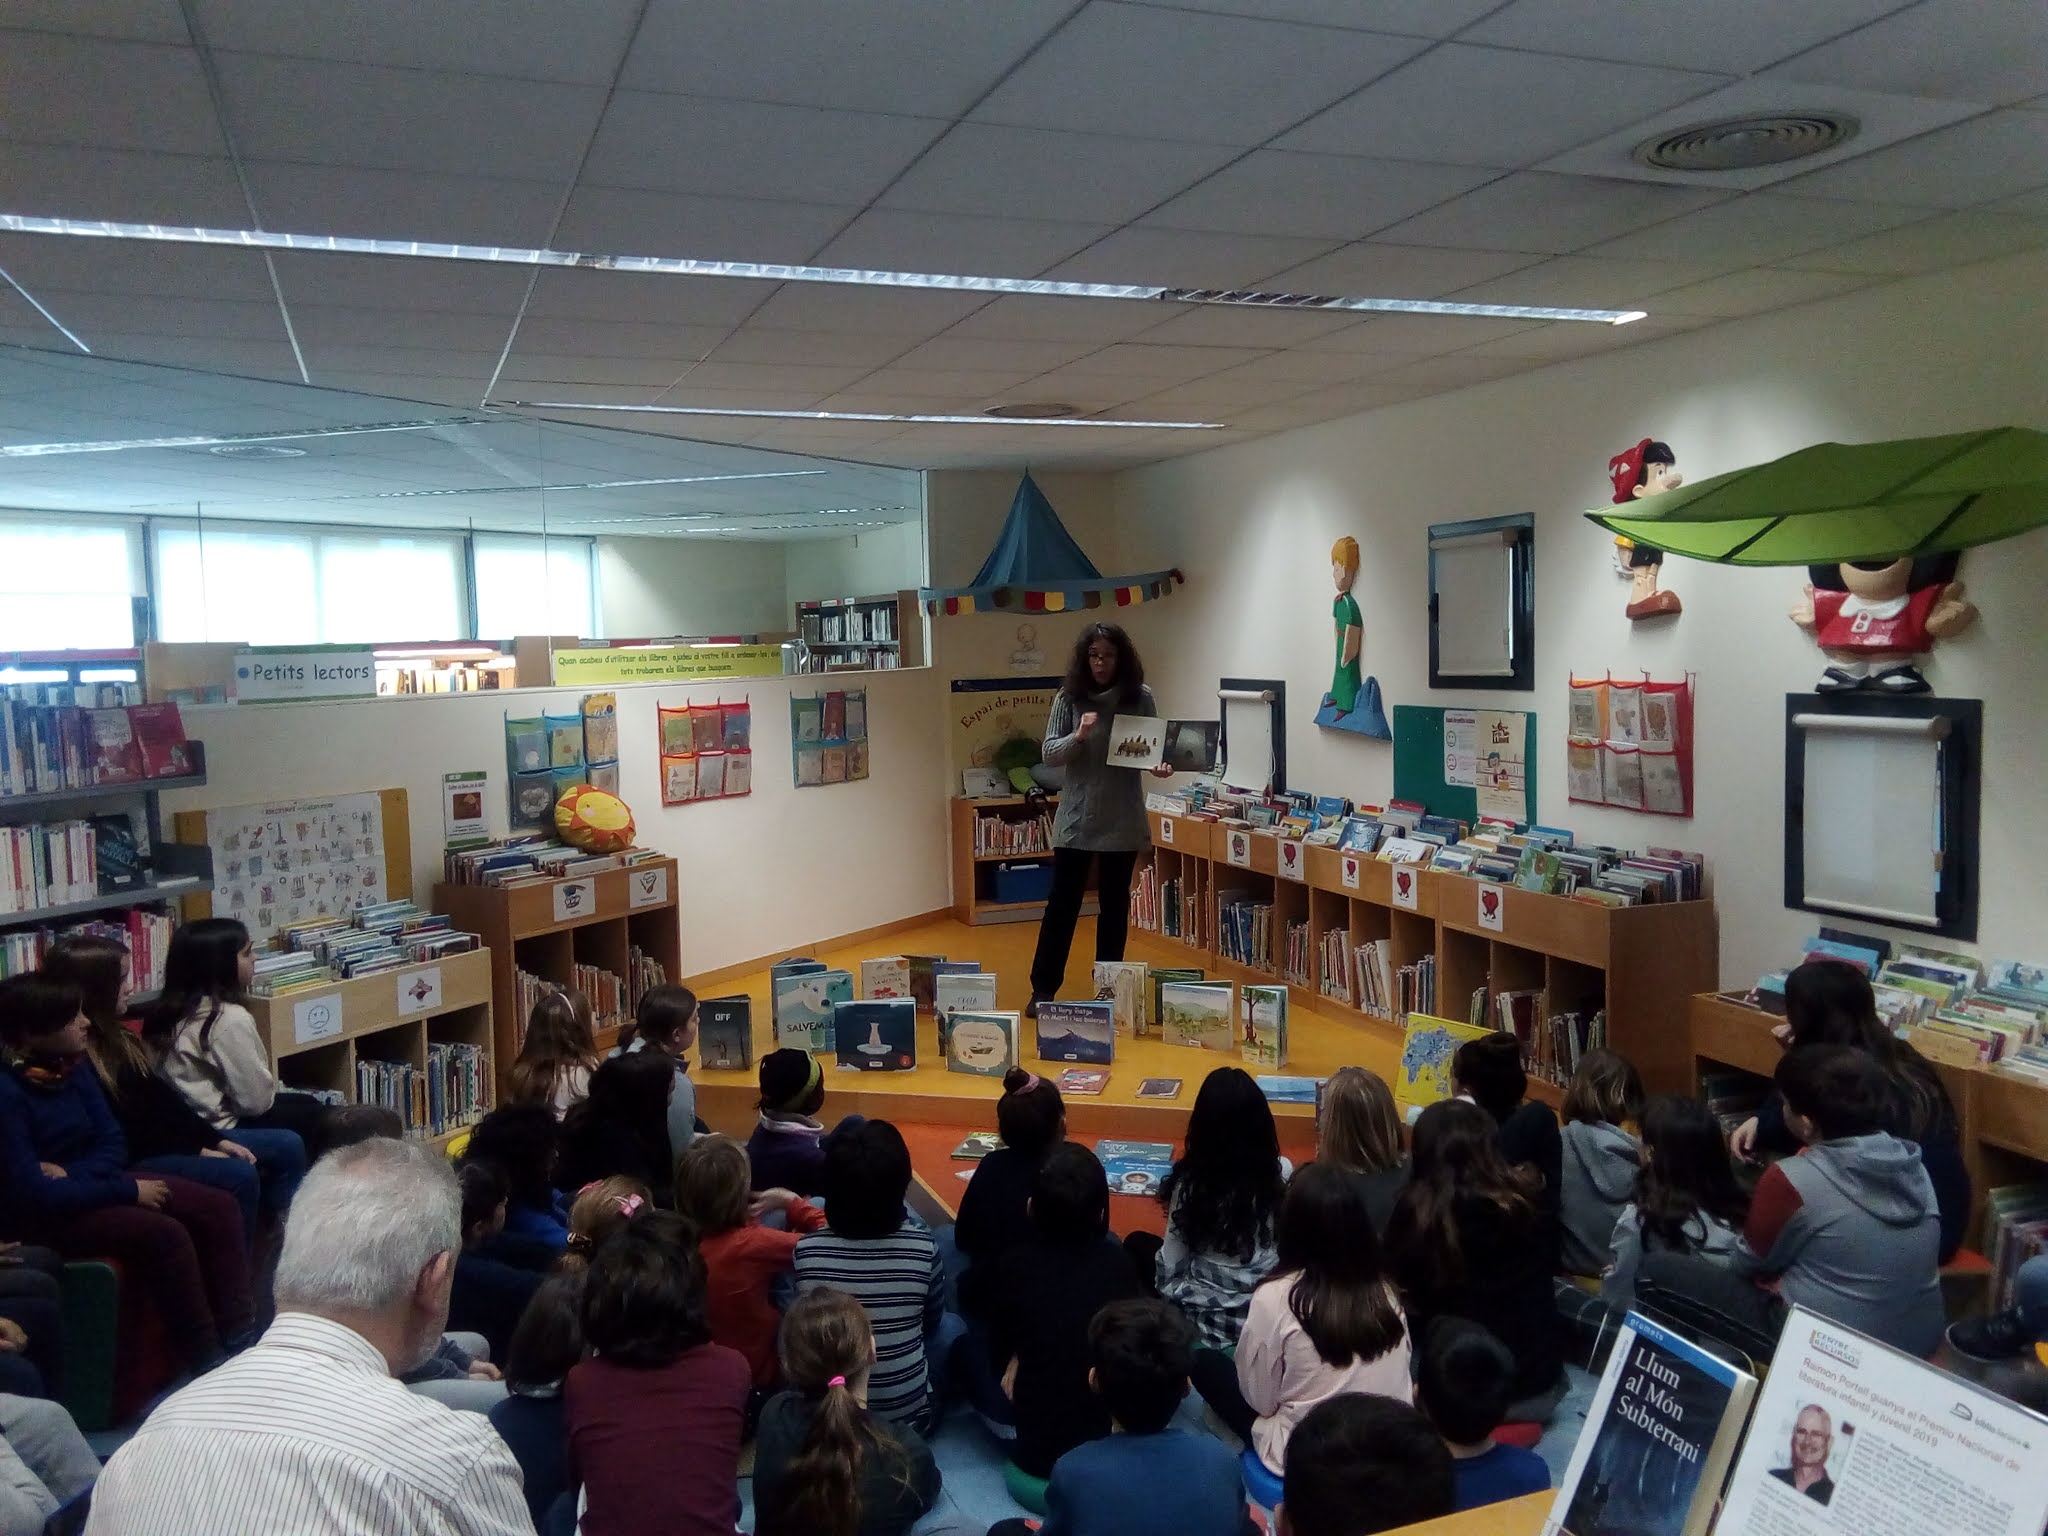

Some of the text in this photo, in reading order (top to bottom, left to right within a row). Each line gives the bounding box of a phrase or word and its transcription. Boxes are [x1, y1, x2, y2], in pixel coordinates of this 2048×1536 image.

[254, 664, 369, 680] Petits lectors
[558, 656, 577, 666] Quan
[579, 656, 602, 664] acabeu
[638, 654, 647, 662] els
[666, 665, 674, 673] els
[960, 703, 992, 729] Espai
[995, 697, 1009, 708] de
[1012, 695, 1045, 708] petits
[715, 1013, 731, 1021] OFF
[787, 1021, 825, 1033] SALVEM
[1815, 1339, 1860, 1366] RECURSOS
[1816, 1331, 1849, 1351] CENTRE
[1634, 1347, 1680, 1389] Llum
[1625, 1374, 1684, 1422] al Món
[1798, 1370, 1938, 1448] literatura infantil y juvenil 2019
[1617, 1395, 1701, 1463] Subterrani
[1839, 1374, 1870, 1396] Portell
[1870, 1392, 1906, 1416] guanya
[1908, 1411, 1917, 1420] el
[1918, 1413, 1954, 1440] Premio
[1957, 1433, 2003, 1463] Nacional
[2005, 1459, 2021, 1472] de
